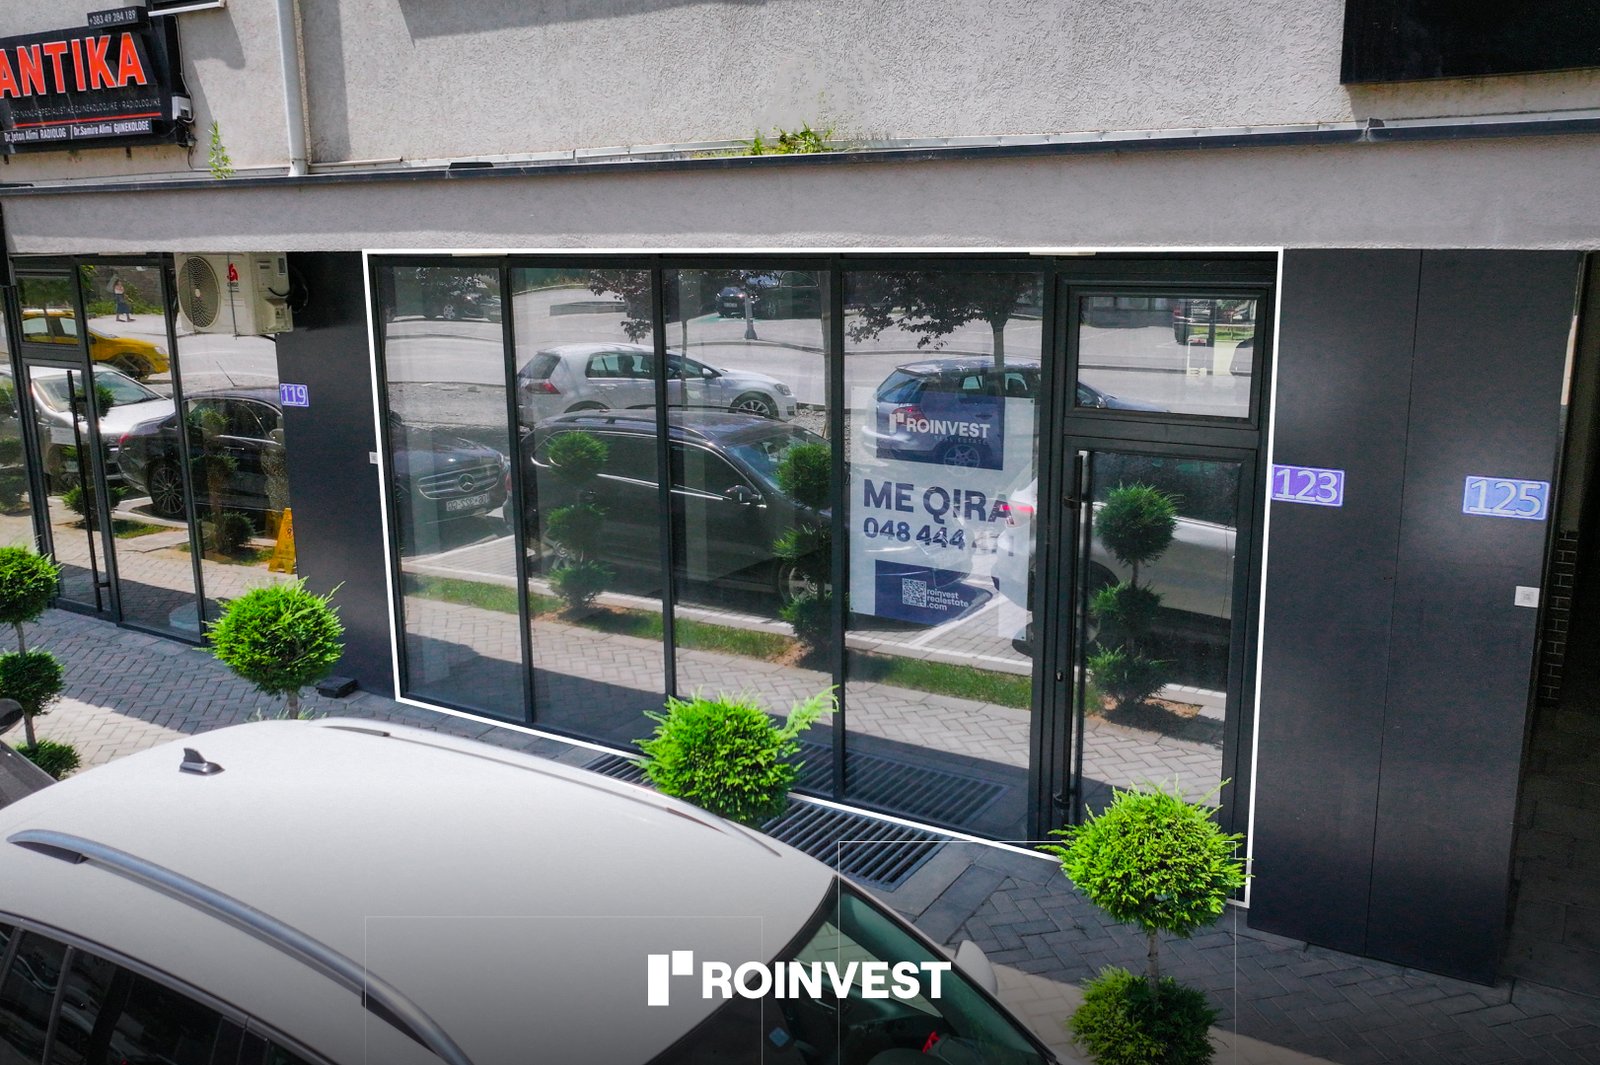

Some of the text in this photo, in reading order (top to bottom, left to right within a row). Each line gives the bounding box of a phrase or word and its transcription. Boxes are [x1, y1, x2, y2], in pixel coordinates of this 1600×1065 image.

[90, 15, 104, 25] +383
[125, 9, 136, 20] 189
[40, 127, 67, 139] RADIOLOG
[281, 385, 306, 405] 119
[906, 417, 991, 439] ROINVEST
[1275, 468, 1338, 503] 123
[863, 479, 1015, 525] ME QIRA
[1468, 479, 1542, 517] 125
[863, 517, 911, 543] 048
[916, 524, 966, 550] 444
[926, 587, 960, 599] roinvest
[926, 595, 969, 607] realestate
[926, 603, 948, 611] .com
